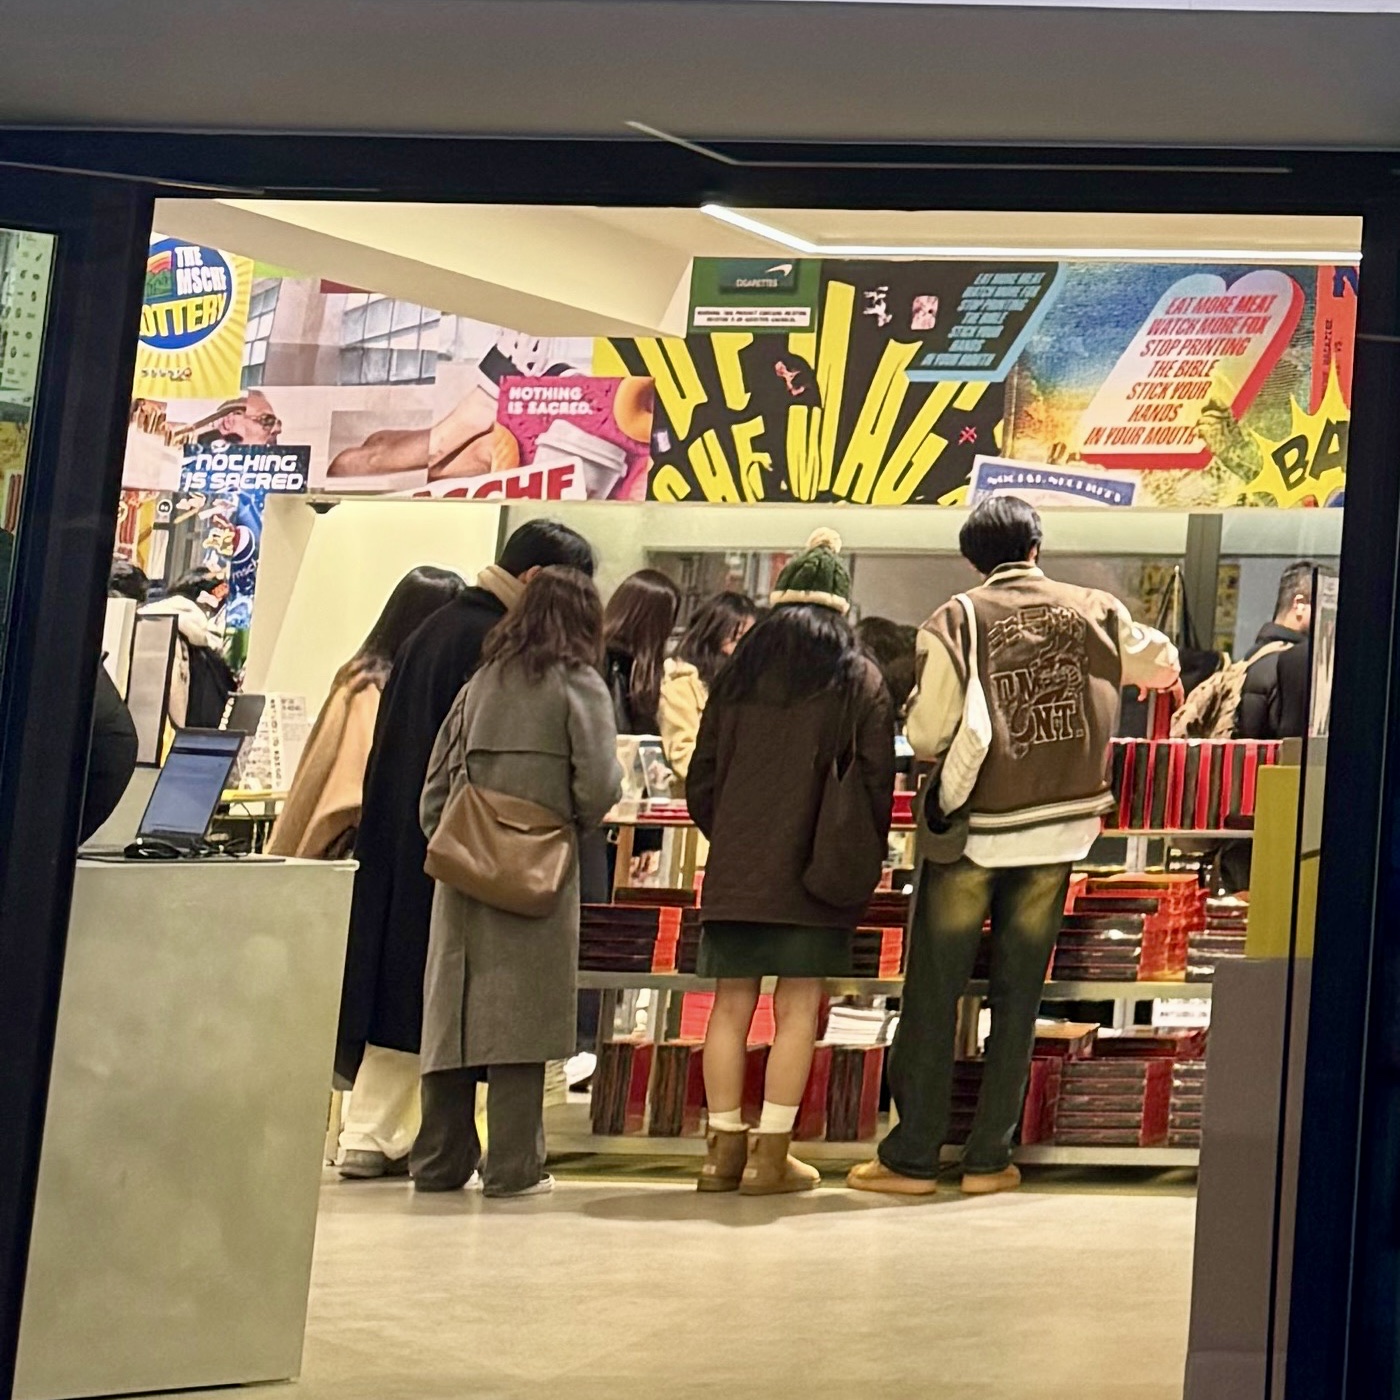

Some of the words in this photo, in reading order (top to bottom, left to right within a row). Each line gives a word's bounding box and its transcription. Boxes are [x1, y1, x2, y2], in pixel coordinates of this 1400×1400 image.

[174, 246, 203, 268] THE
[1165, 295, 1197, 315] EAT
[1198, 295, 1235, 314] MORE
[1232, 294, 1278, 313] MEAT
[1146, 318, 1203, 337] WATCH
[1200, 317, 1241, 335] MORE
[1237, 316, 1271, 334] FOX
[1140, 338, 1184, 357] STOP
[1180, 337, 1251, 356] PRINTING
[1148, 360, 1176, 378] THE
[1174, 359, 1219, 377] BIBLE
[509, 386, 583, 401] NOTHING
[1126, 382, 1173, 400] STICK
[1168, 381, 1212, 400] YOUR
[508, 401, 524, 415] IS
[527, 401, 593, 416] SACRED.
[1127, 403, 1183, 423] HANDS
[1084, 427, 1104, 446] IN
[1101, 427, 1146, 446] YOUR
[195, 454, 298, 472] NOTHING
[185, 472, 207, 492] IS
[210, 472, 304, 491] SACRED
